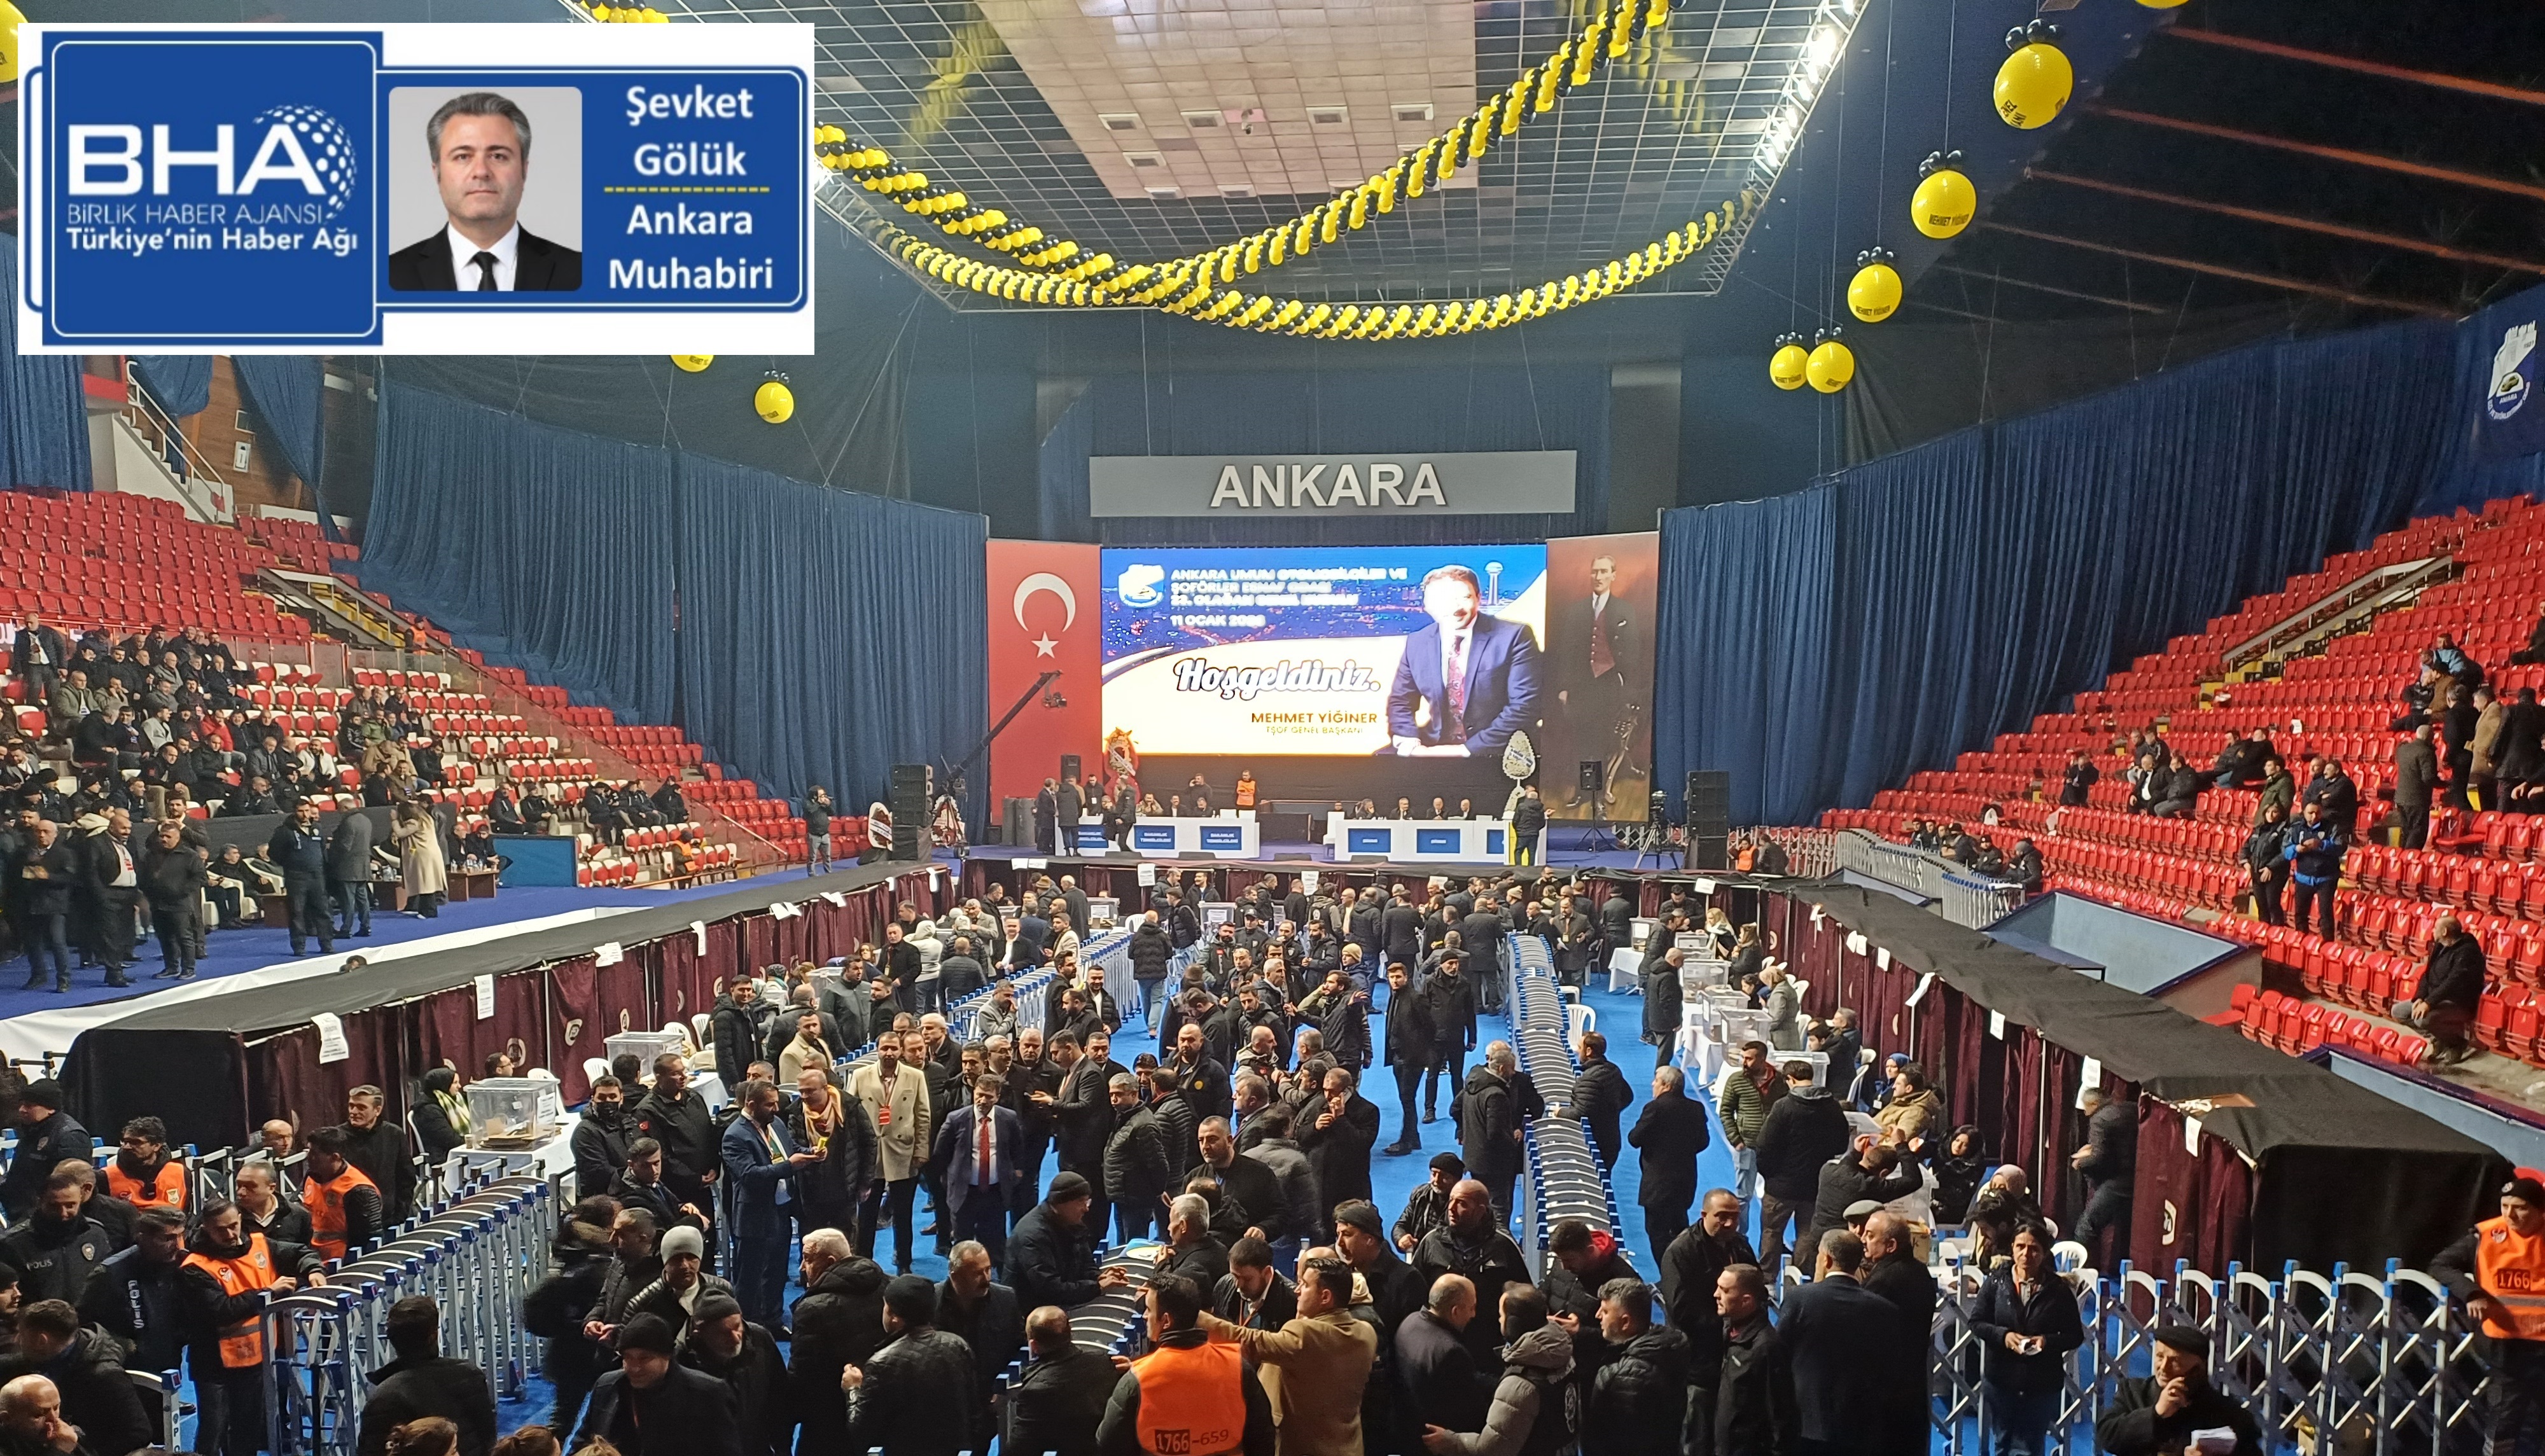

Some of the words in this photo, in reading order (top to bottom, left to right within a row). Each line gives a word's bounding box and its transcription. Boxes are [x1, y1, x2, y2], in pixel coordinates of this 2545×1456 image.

[1210, 463, 1447, 508] ANKARA
[1171, 569, 1228, 580] ANKARA
[1171, 580, 1240, 595] ŞOFÖRLER
[1170, 615, 1183, 626] 11
[1185, 614, 1227, 627] OCAK
[1173, 658, 1381, 701] Hoşgeldiniz.
[1252, 713, 1314, 723] MEHMET
[1318, 711, 1377, 723] YİĞİNER
[1322, 726, 1363, 735] BAŞKANI
[2499, 1272, 2530, 1289] 1766
